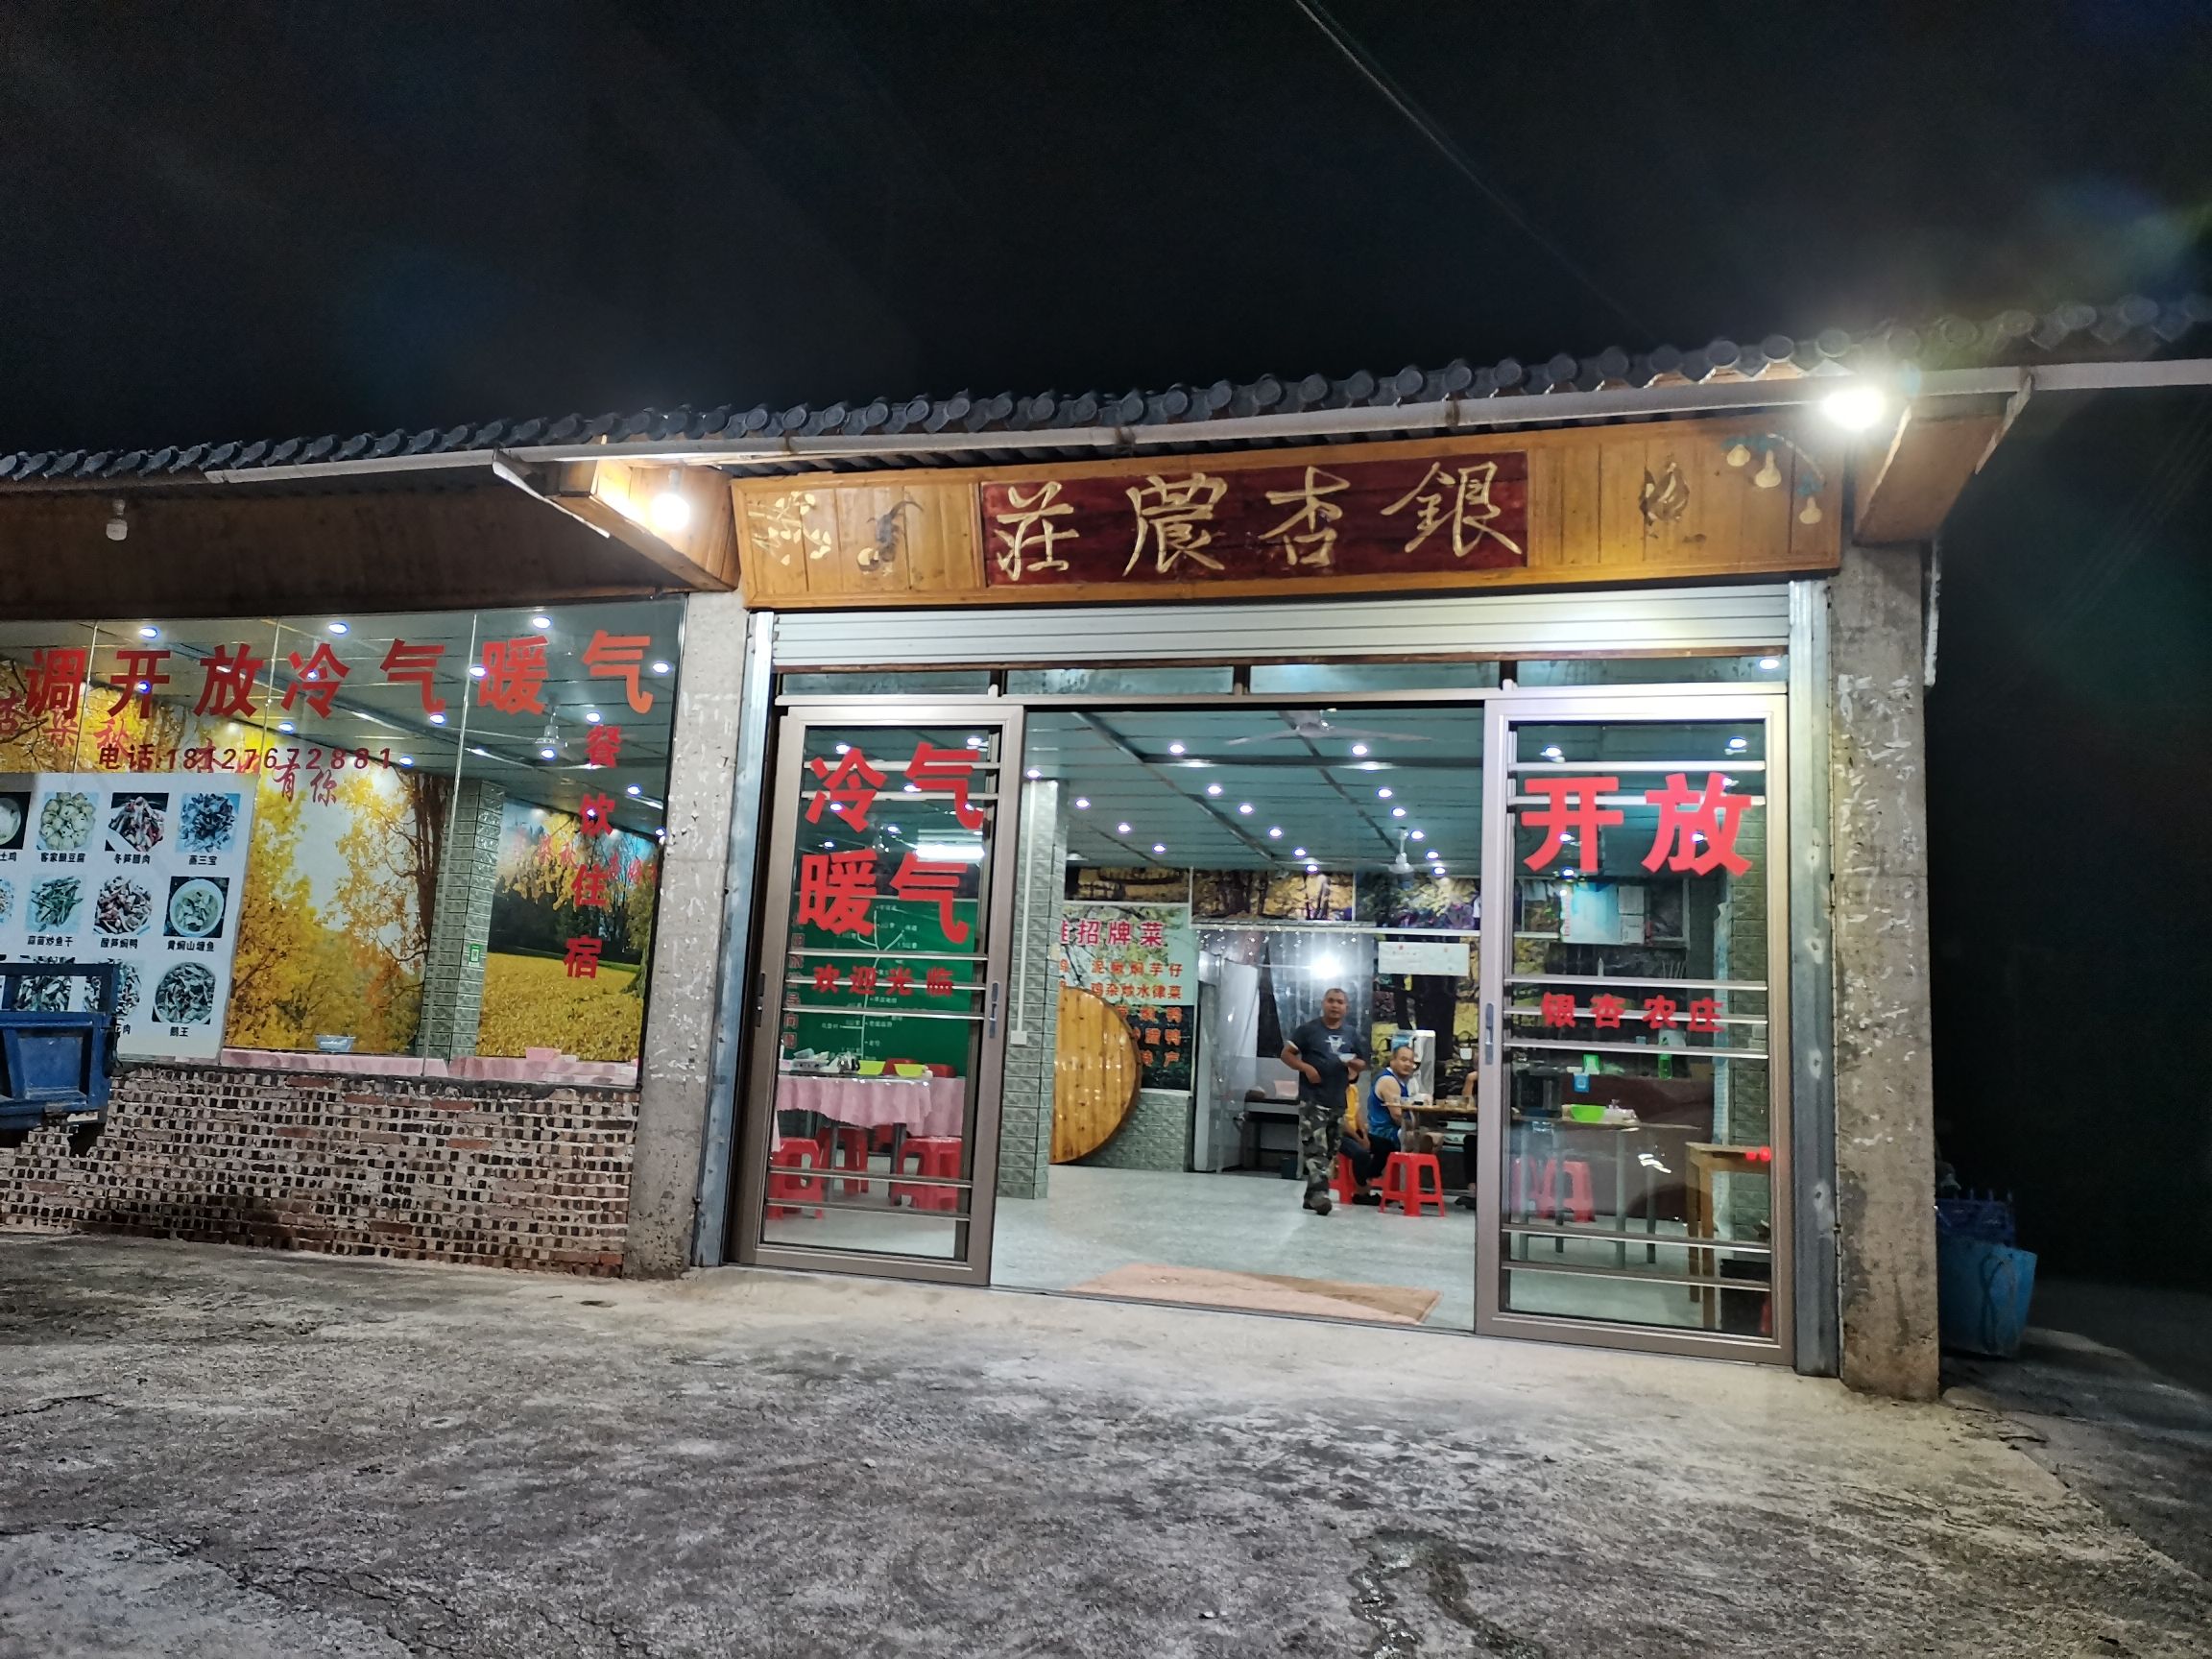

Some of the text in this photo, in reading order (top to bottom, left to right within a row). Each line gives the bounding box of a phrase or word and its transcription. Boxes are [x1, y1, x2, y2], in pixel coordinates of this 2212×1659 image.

[24, 630, 655, 718] 调开放冷气暖气
[805, 741, 984, 832] 冷气
[1521, 770, 1753, 877] 开放
[563, 724, 622, 979] 餐饮住宿
[799, 848, 969, 943] 暖气
[811, 964, 953, 998] 欢迎光临
[1540, 992, 1724, 1033] 银杏农庄
